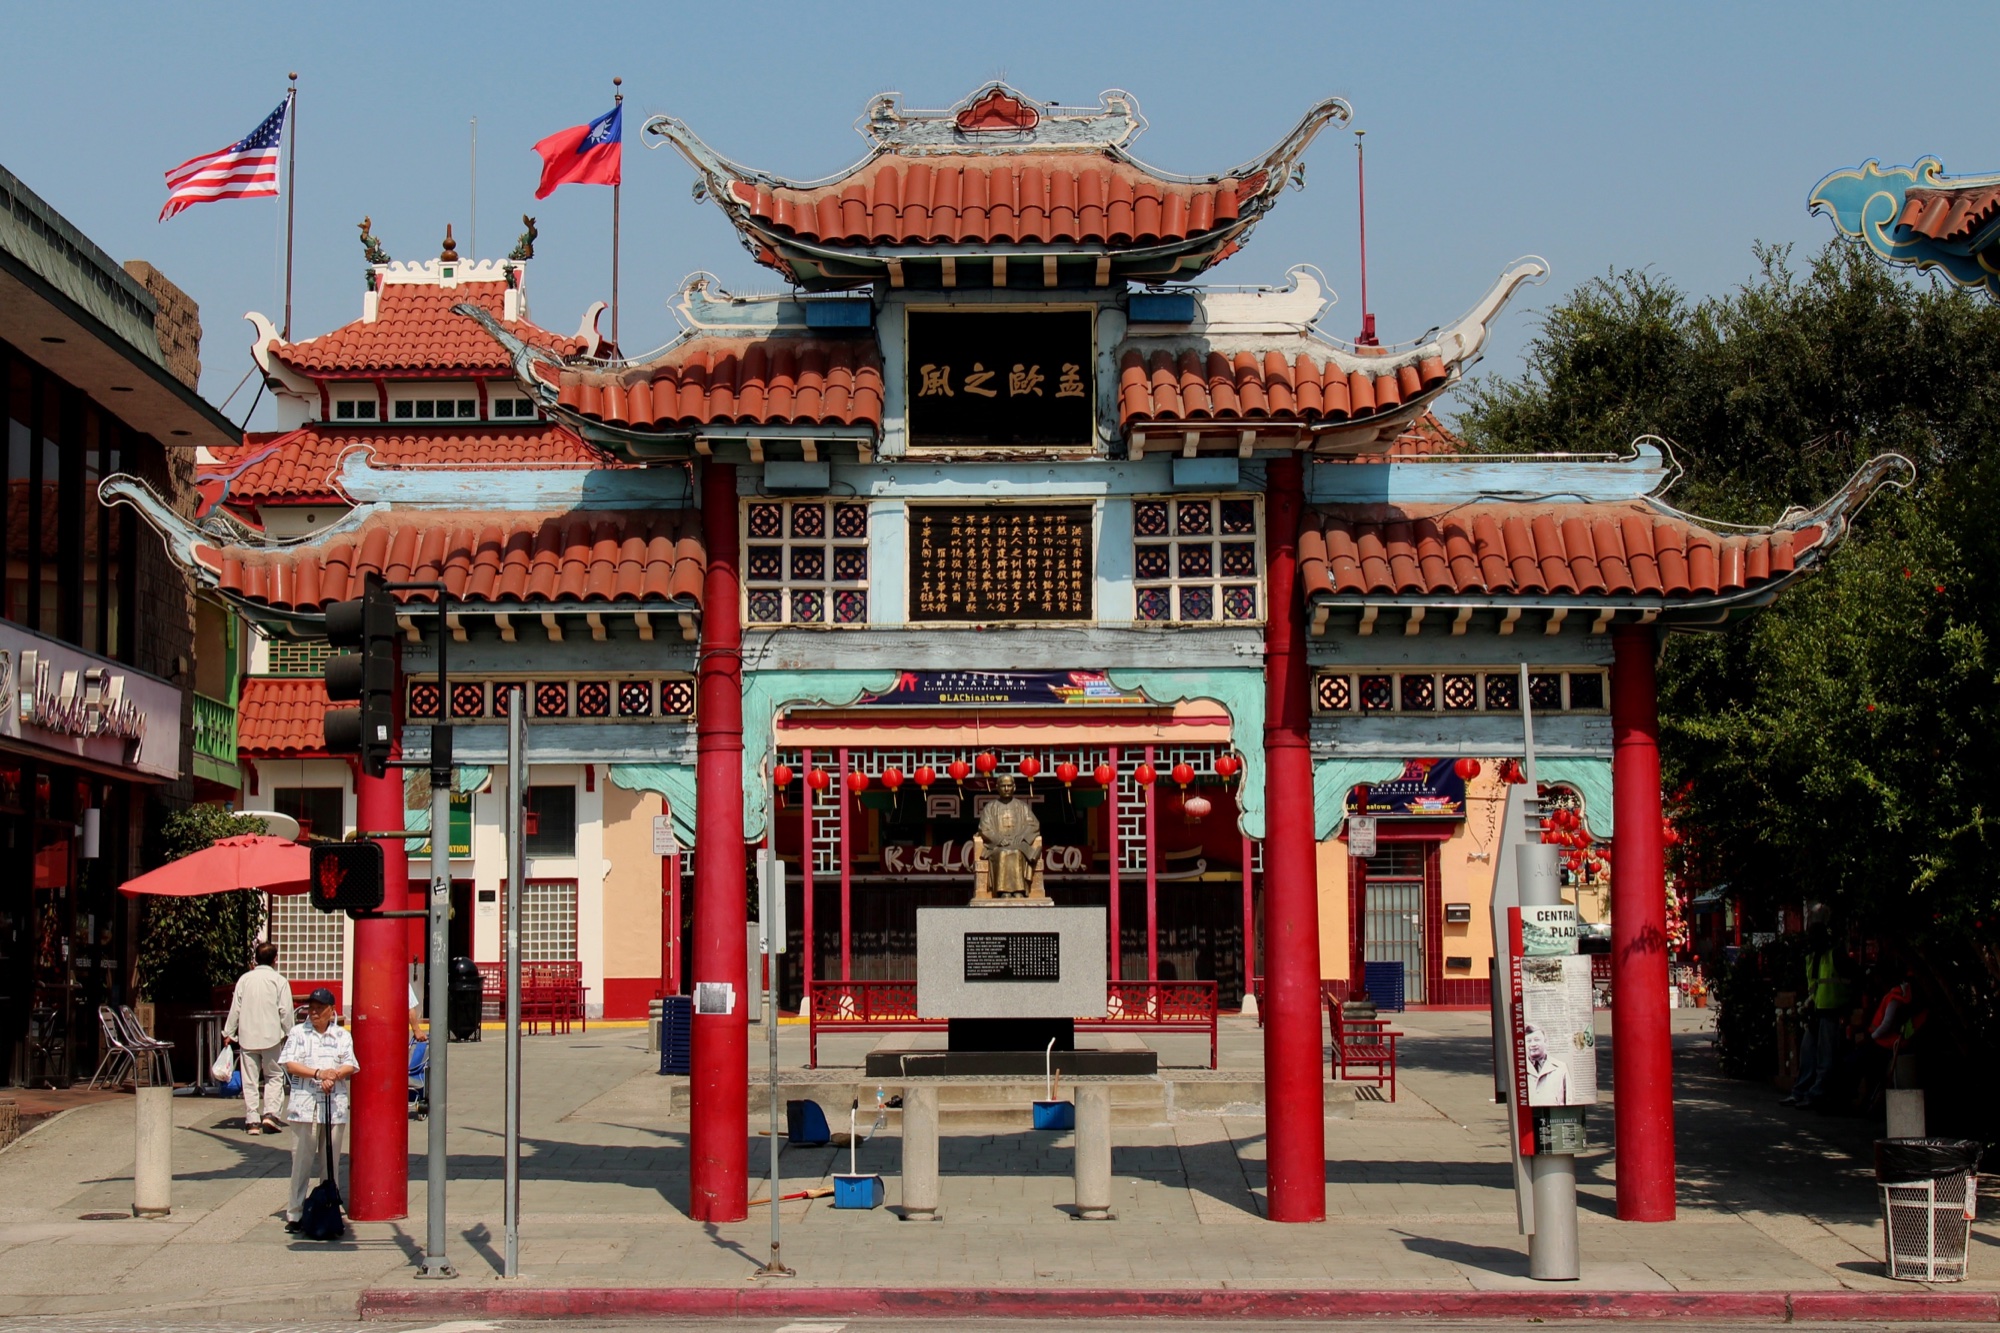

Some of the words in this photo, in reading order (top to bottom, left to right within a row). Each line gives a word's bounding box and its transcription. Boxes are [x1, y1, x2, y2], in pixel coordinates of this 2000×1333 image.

[939, 693, 1009, 702] @LAChinatown
[1536, 910, 1576, 922] CENTRAL
[1512, 955, 1522, 997] ANGELS
[1515, 1002, 1524, 1033] WALK
[1517, 1039, 1528, 1106] CHINATOWN
